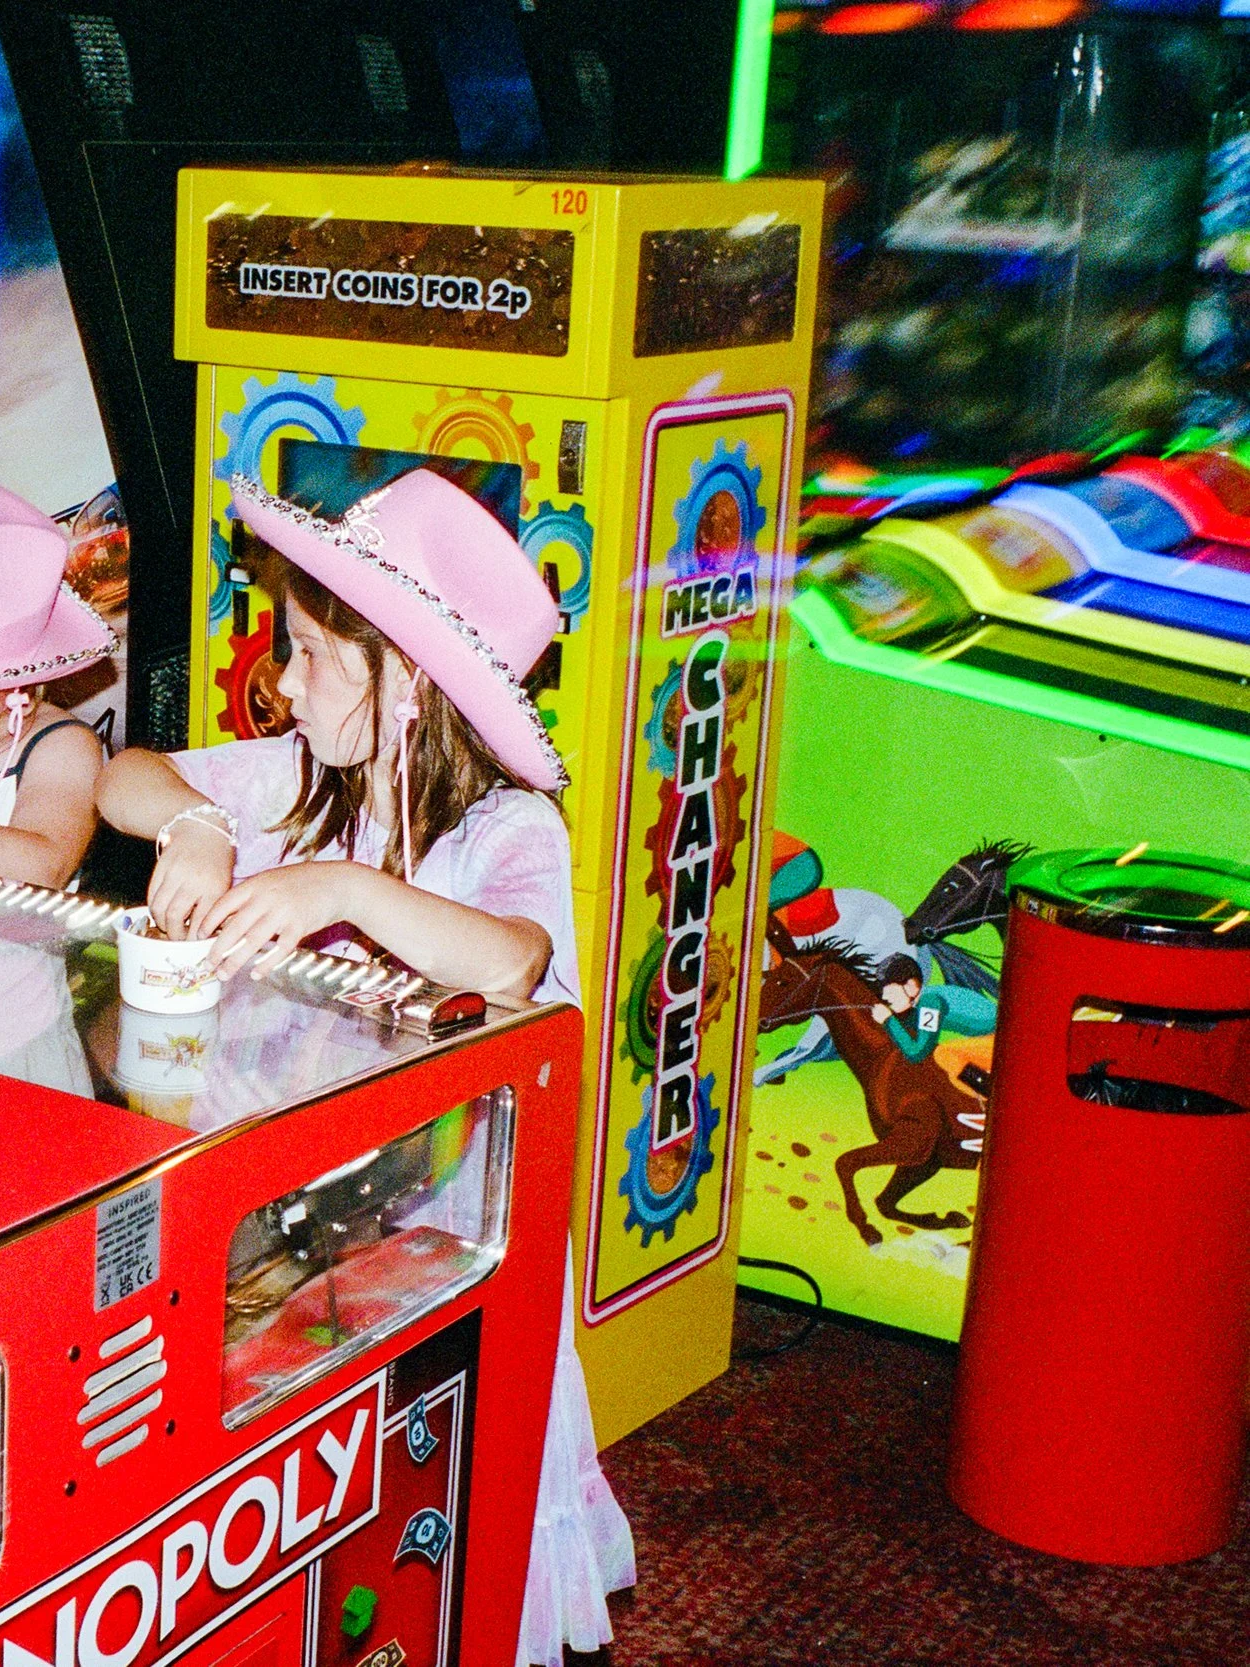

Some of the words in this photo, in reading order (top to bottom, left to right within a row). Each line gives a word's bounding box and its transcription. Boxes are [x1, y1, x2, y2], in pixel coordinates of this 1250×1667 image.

[551, 190, 587, 215] 120
[241, 265, 329, 297] INSERT
[334, 271, 417, 303] COINS
[424, 277, 482, 309] FOR
[487, 280, 530, 317] 2p
[663, 569, 754, 635] MEGA
[655, 636, 725, 1146] CHANGER
[923, 1011, 934, 1028] 2
[108, 1188, 150, 1218] INSPIRED
